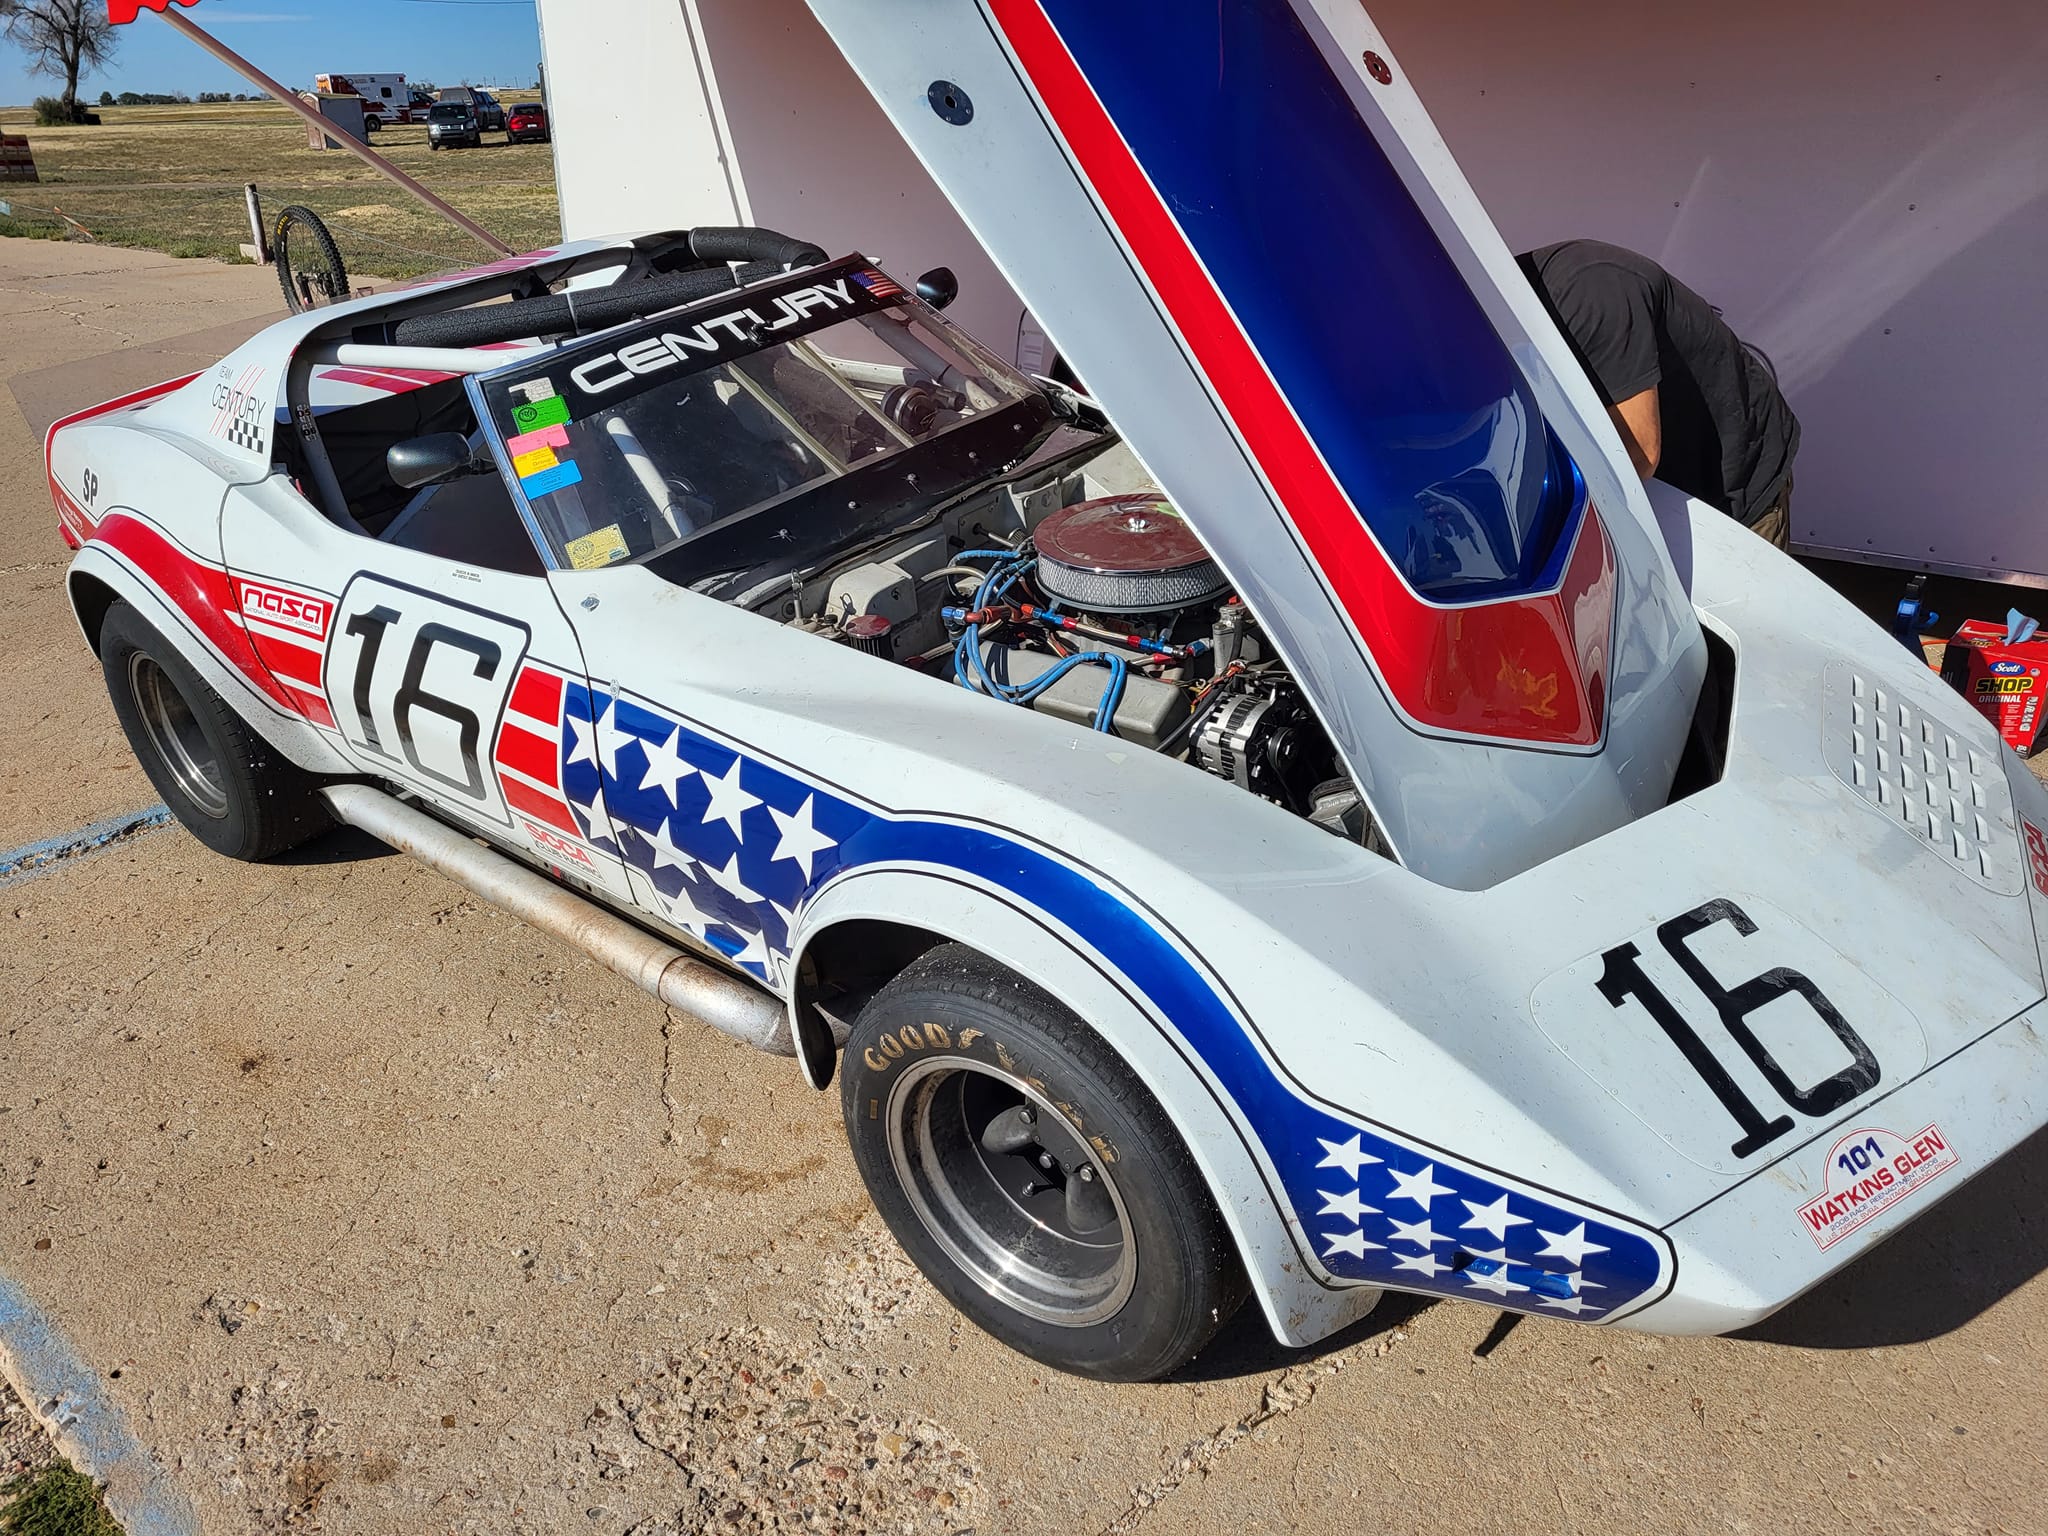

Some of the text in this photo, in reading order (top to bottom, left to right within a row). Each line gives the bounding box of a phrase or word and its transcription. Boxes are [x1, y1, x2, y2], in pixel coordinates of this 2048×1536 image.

[570, 278, 856, 394] CENTURY
[220, 365, 234, 381] TEAM
[211, 383, 267, 425] CENTURY
[83, 467, 98, 507] SP
[1975, 676, 2034, 694] SHOP
[1995, 662, 2021, 673] Scott
[345, 604, 502, 801] 16
[1979, 694, 2022, 703] ORIGINAL
[524, 822, 596, 868] SCCA
[1593, 897, 1882, 1160] 16
[1838, 1136, 1885, 1177] 101
[1803, 1129, 1946, 1232] WATKINS GLEN
[1839, 1218, 1860, 1234] ZIPPO
[1860, 1204, 1880, 1220] SVRA
[1880, 1185, 1907, 1207] VINTAGE
[1909, 1169, 1934, 1188] GRAND
[1935, 1157, 1951, 1172] PRIX
[1850, 1202, 1869, 1219] RACE
[1870, 1170, 1919, 1205] REENACTMENT
